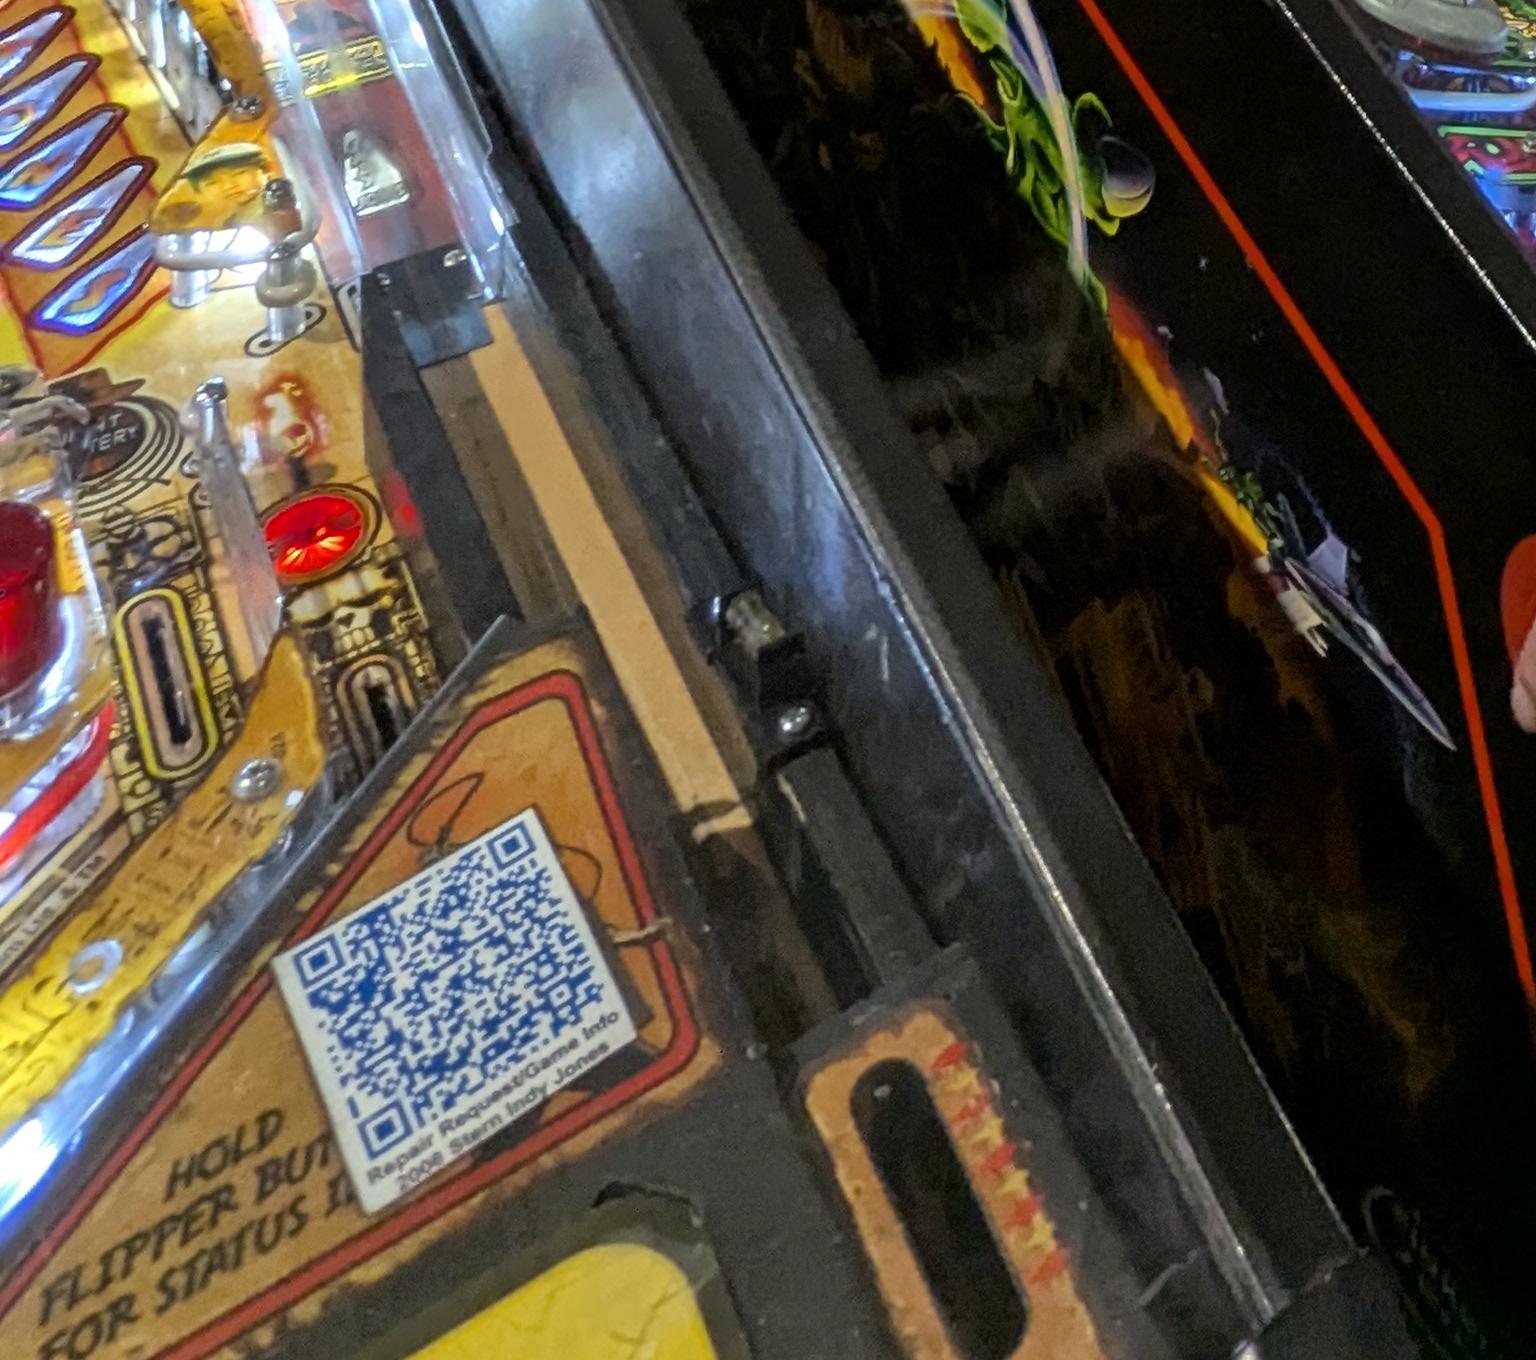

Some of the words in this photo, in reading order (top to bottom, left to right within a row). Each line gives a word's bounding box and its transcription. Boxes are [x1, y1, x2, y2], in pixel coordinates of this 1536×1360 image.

[163, 1107, 285, 1204] HOLD
[367, 1134, 435, 1186] Repair
[437, 1036, 580, 1136] Request/Game
[581, 1010, 620, 1042] Info
[448, 1113, 503, 1155] Stern
[505, 1083, 549, 1118] Indy
[553, 1041, 611, 1086] Jones
[37, 1292, 141, 1360] FOR
[155, 1192, 310, 1316] STATUS
[38, 1183, 239, 1326] FLIPPER
[253, 1130, 333, 1206] BUT
